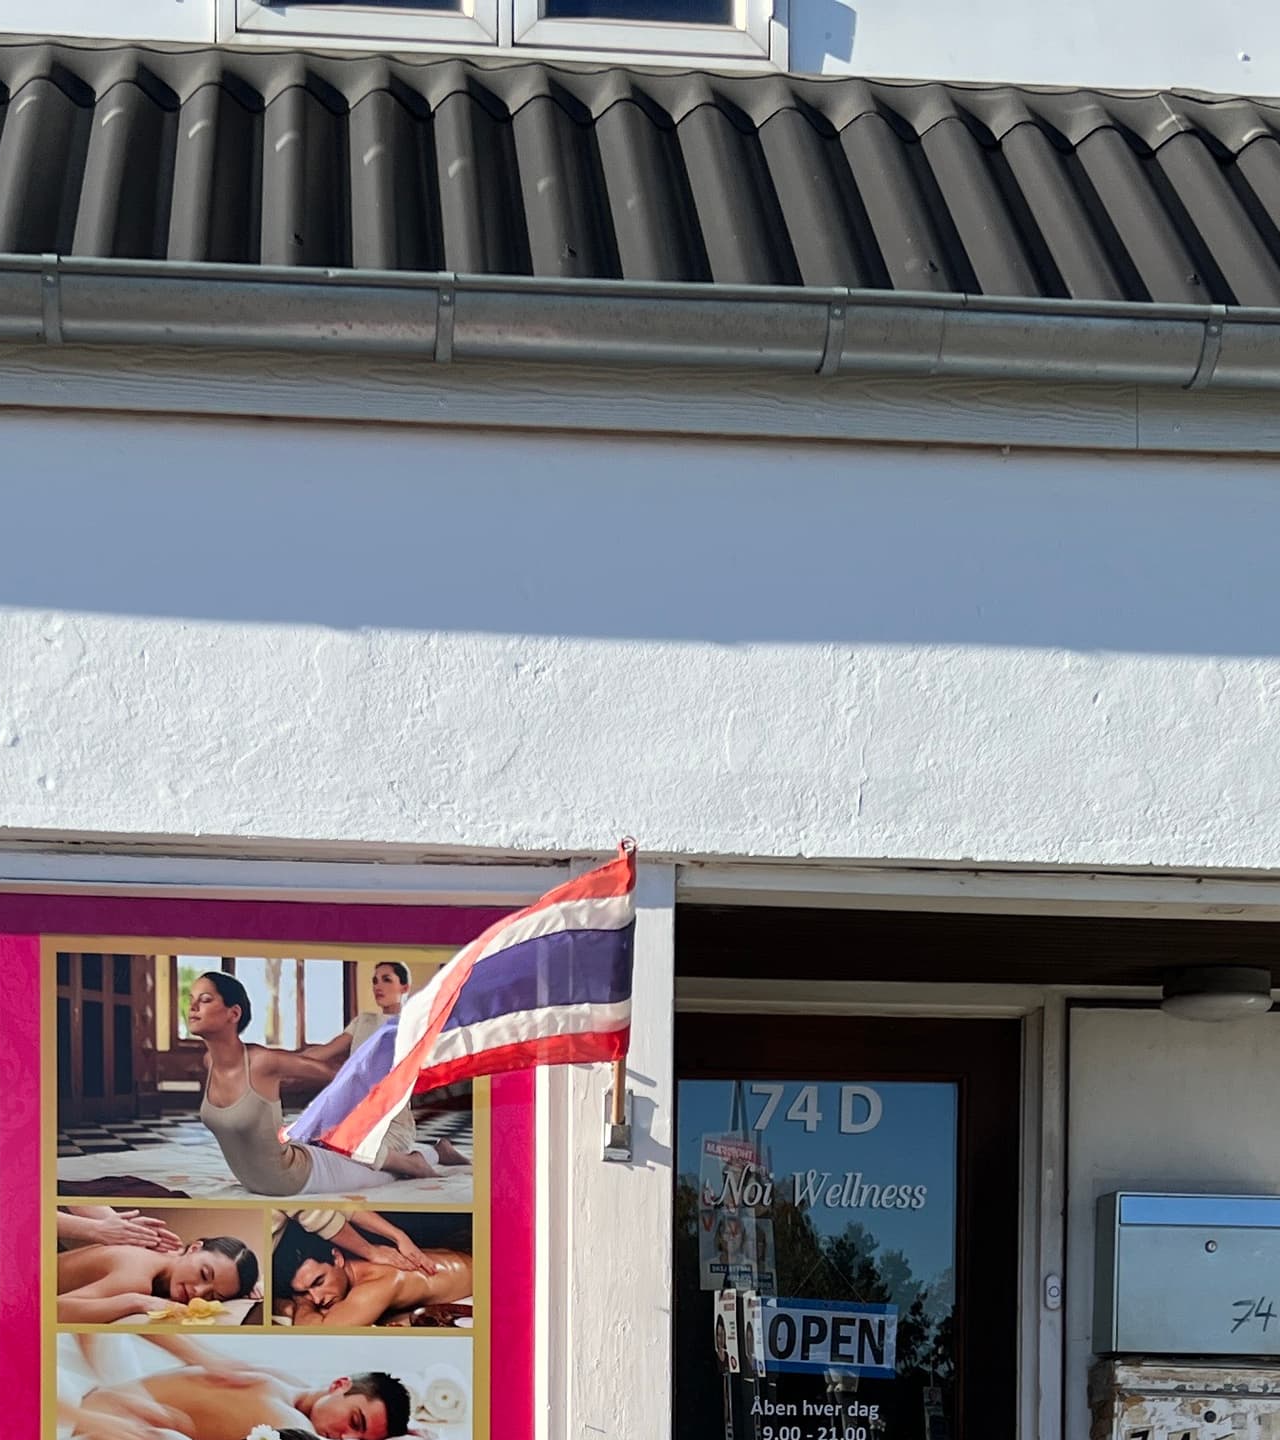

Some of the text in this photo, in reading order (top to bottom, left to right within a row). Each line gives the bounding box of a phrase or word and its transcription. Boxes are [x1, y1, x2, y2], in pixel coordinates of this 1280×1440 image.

[751, 1084, 883, 1134] 74 D
[707, 1163, 928, 1209] Noi Wellness
[769, 1313, 887, 1365] OPEN
[750, 1396, 880, 1420] Åben hver dag
